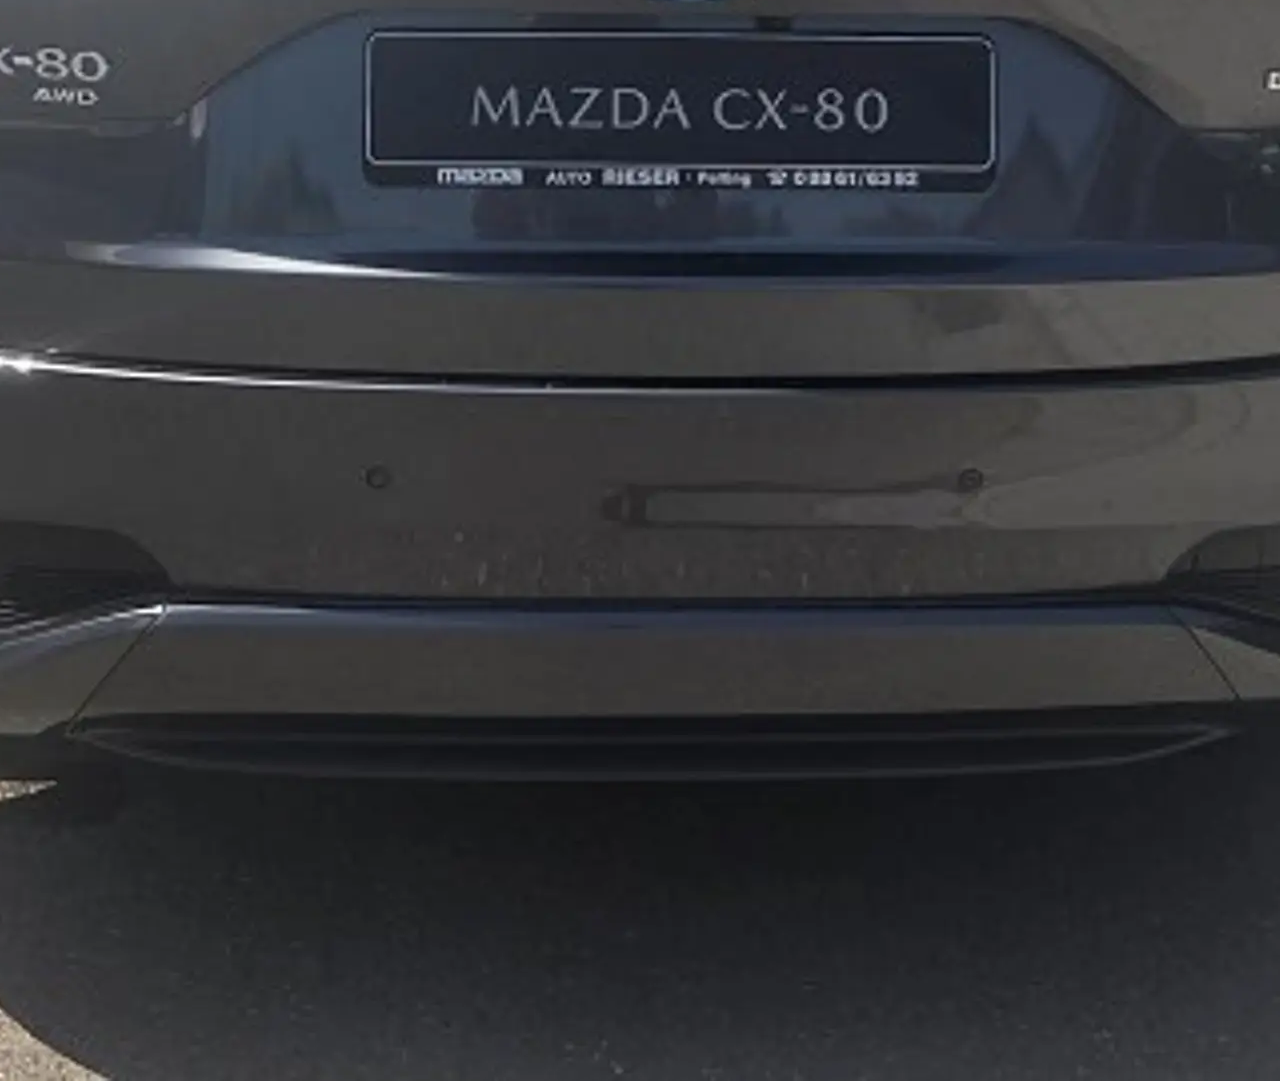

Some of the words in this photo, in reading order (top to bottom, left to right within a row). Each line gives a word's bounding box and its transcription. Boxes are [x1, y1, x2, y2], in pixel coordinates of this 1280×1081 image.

[32, 87, 99, 107] AWD
[470, 85, 692, 130] MAZDA
[713, 87, 889, 132] CX-80
[545, 171, 592, 186] AUTO
[601, 169, 680, 186] RIESER
